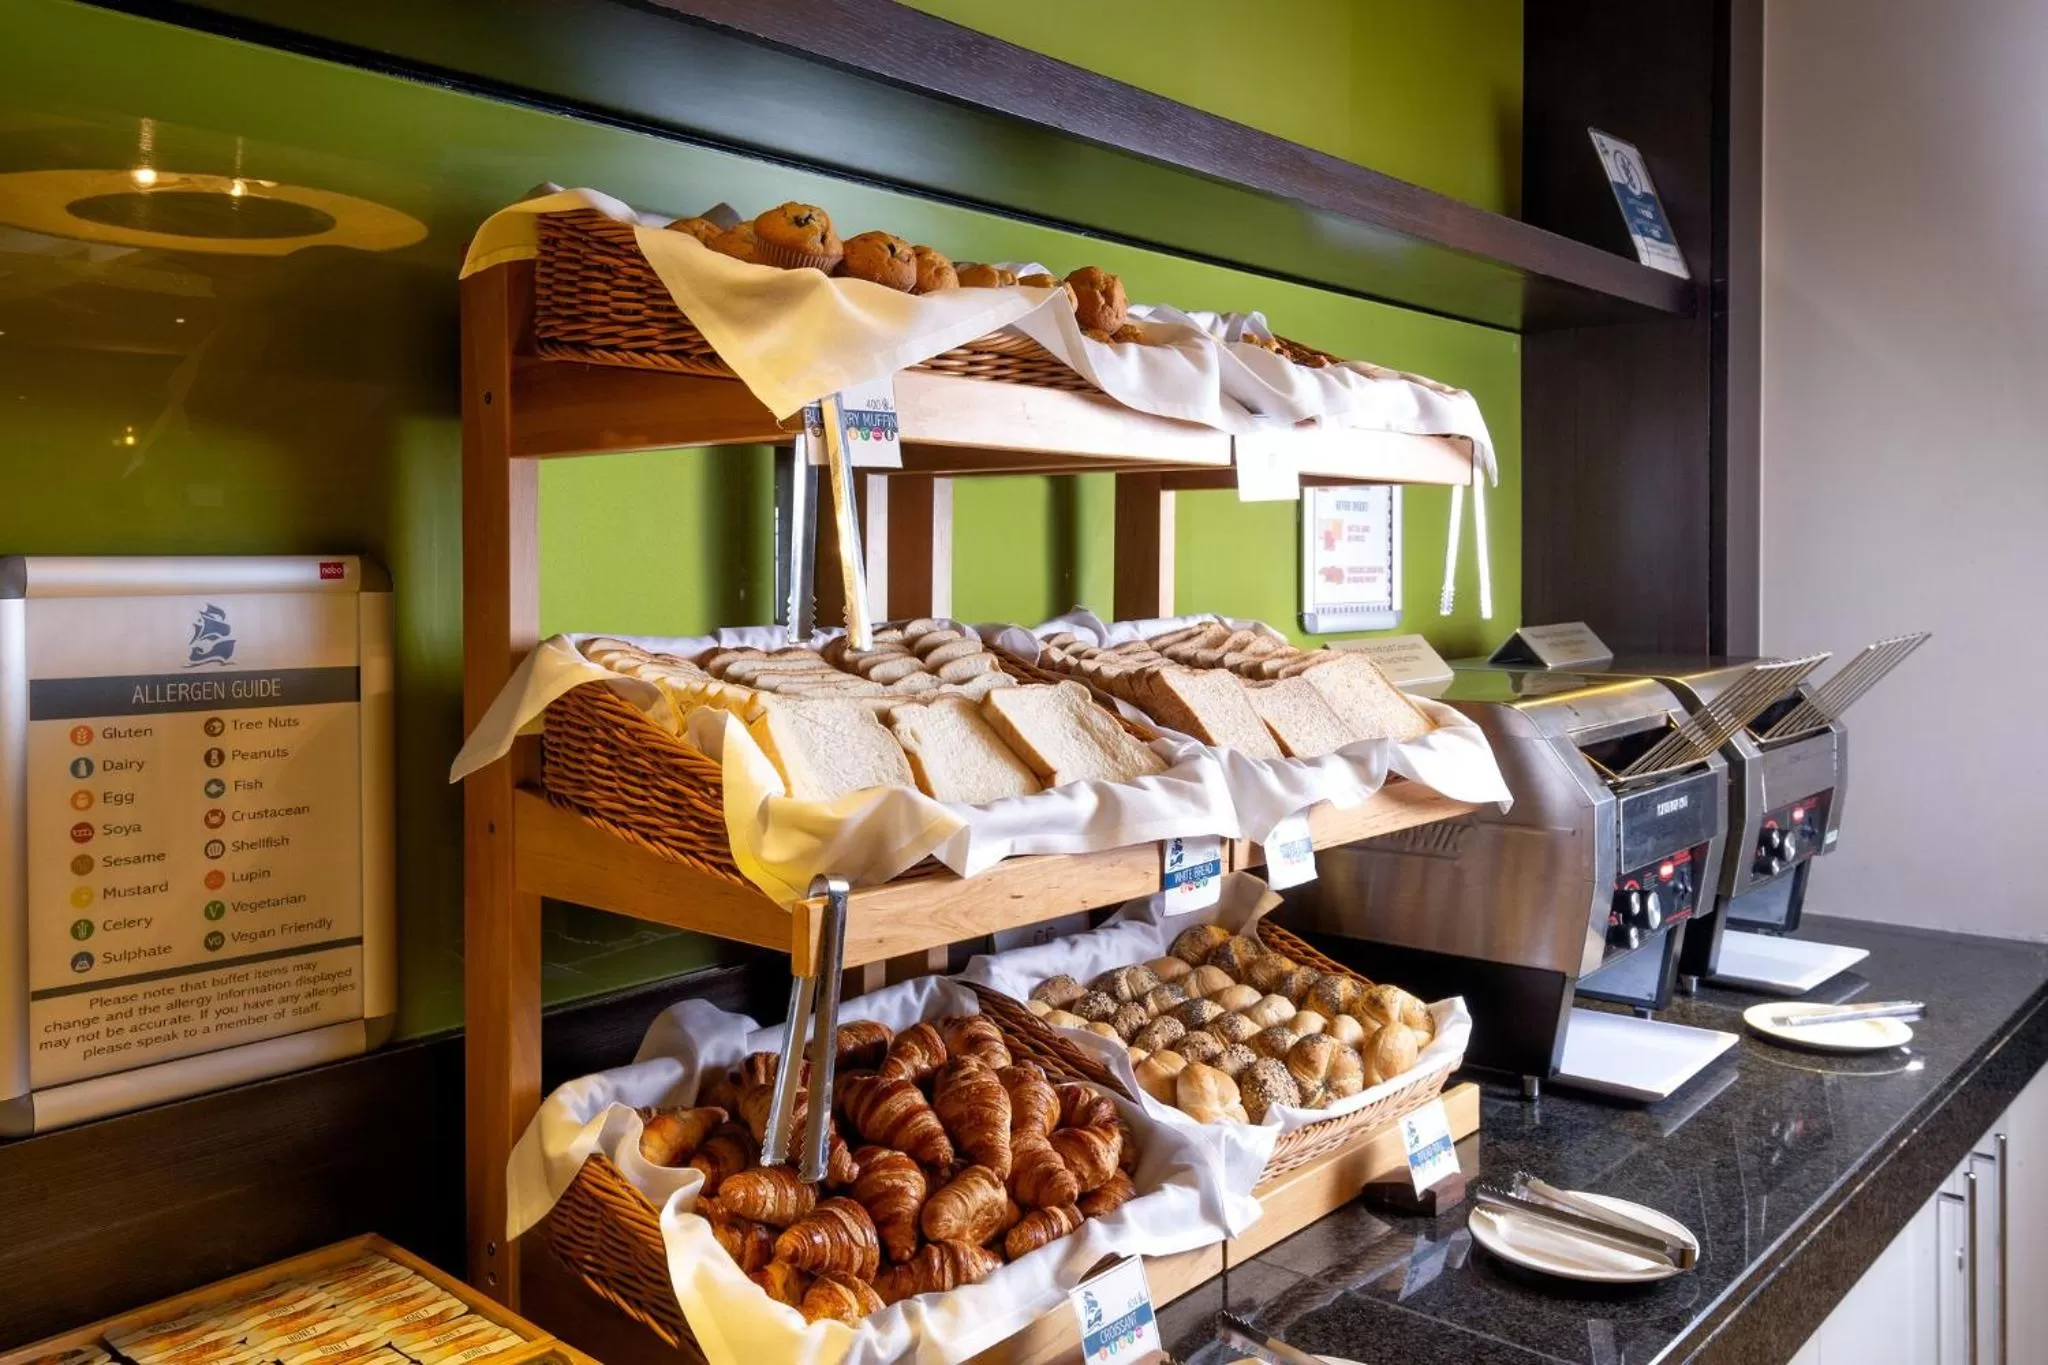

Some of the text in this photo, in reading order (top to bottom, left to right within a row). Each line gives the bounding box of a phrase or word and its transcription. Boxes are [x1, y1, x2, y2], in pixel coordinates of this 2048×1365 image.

[132, 678, 281, 704] ALLERGEN GUIDE
[232, 716, 300, 730] Tree Nuts
[102, 727, 153, 740] Gluten
[231, 747, 289, 761] Peanuts
[102, 759, 145, 773] Dairy
[234, 779, 263, 792] Fish
[103, 791, 135, 806] Egg
[231, 805, 310, 822] Crustacean
[102, 823, 143, 836] Soya
[231, 835, 290, 853] Shellfish
[102, 852, 167, 868] Sesame
[232, 868, 271, 883] Lupin
[103, 880, 169, 900] Mustard
[231, 894, 306, 913] Vegetarian
[102, 916, 153, 932] Celery
[231, 917, 333, 943] Vegan Friendly
[102, 944, 173, 964] Sulphate
[89, 961, 318, 1010] Please note that buffet items may
[44, 967, 352, 1034] change and the allergy information displayed
[39, 982, 356, 1051] may not be accurate. If you have any allergies
[83, 1001, 321, 1061] please speak to a member of staff.
[1100, 1311, 1137, 1344] CROISSANT
